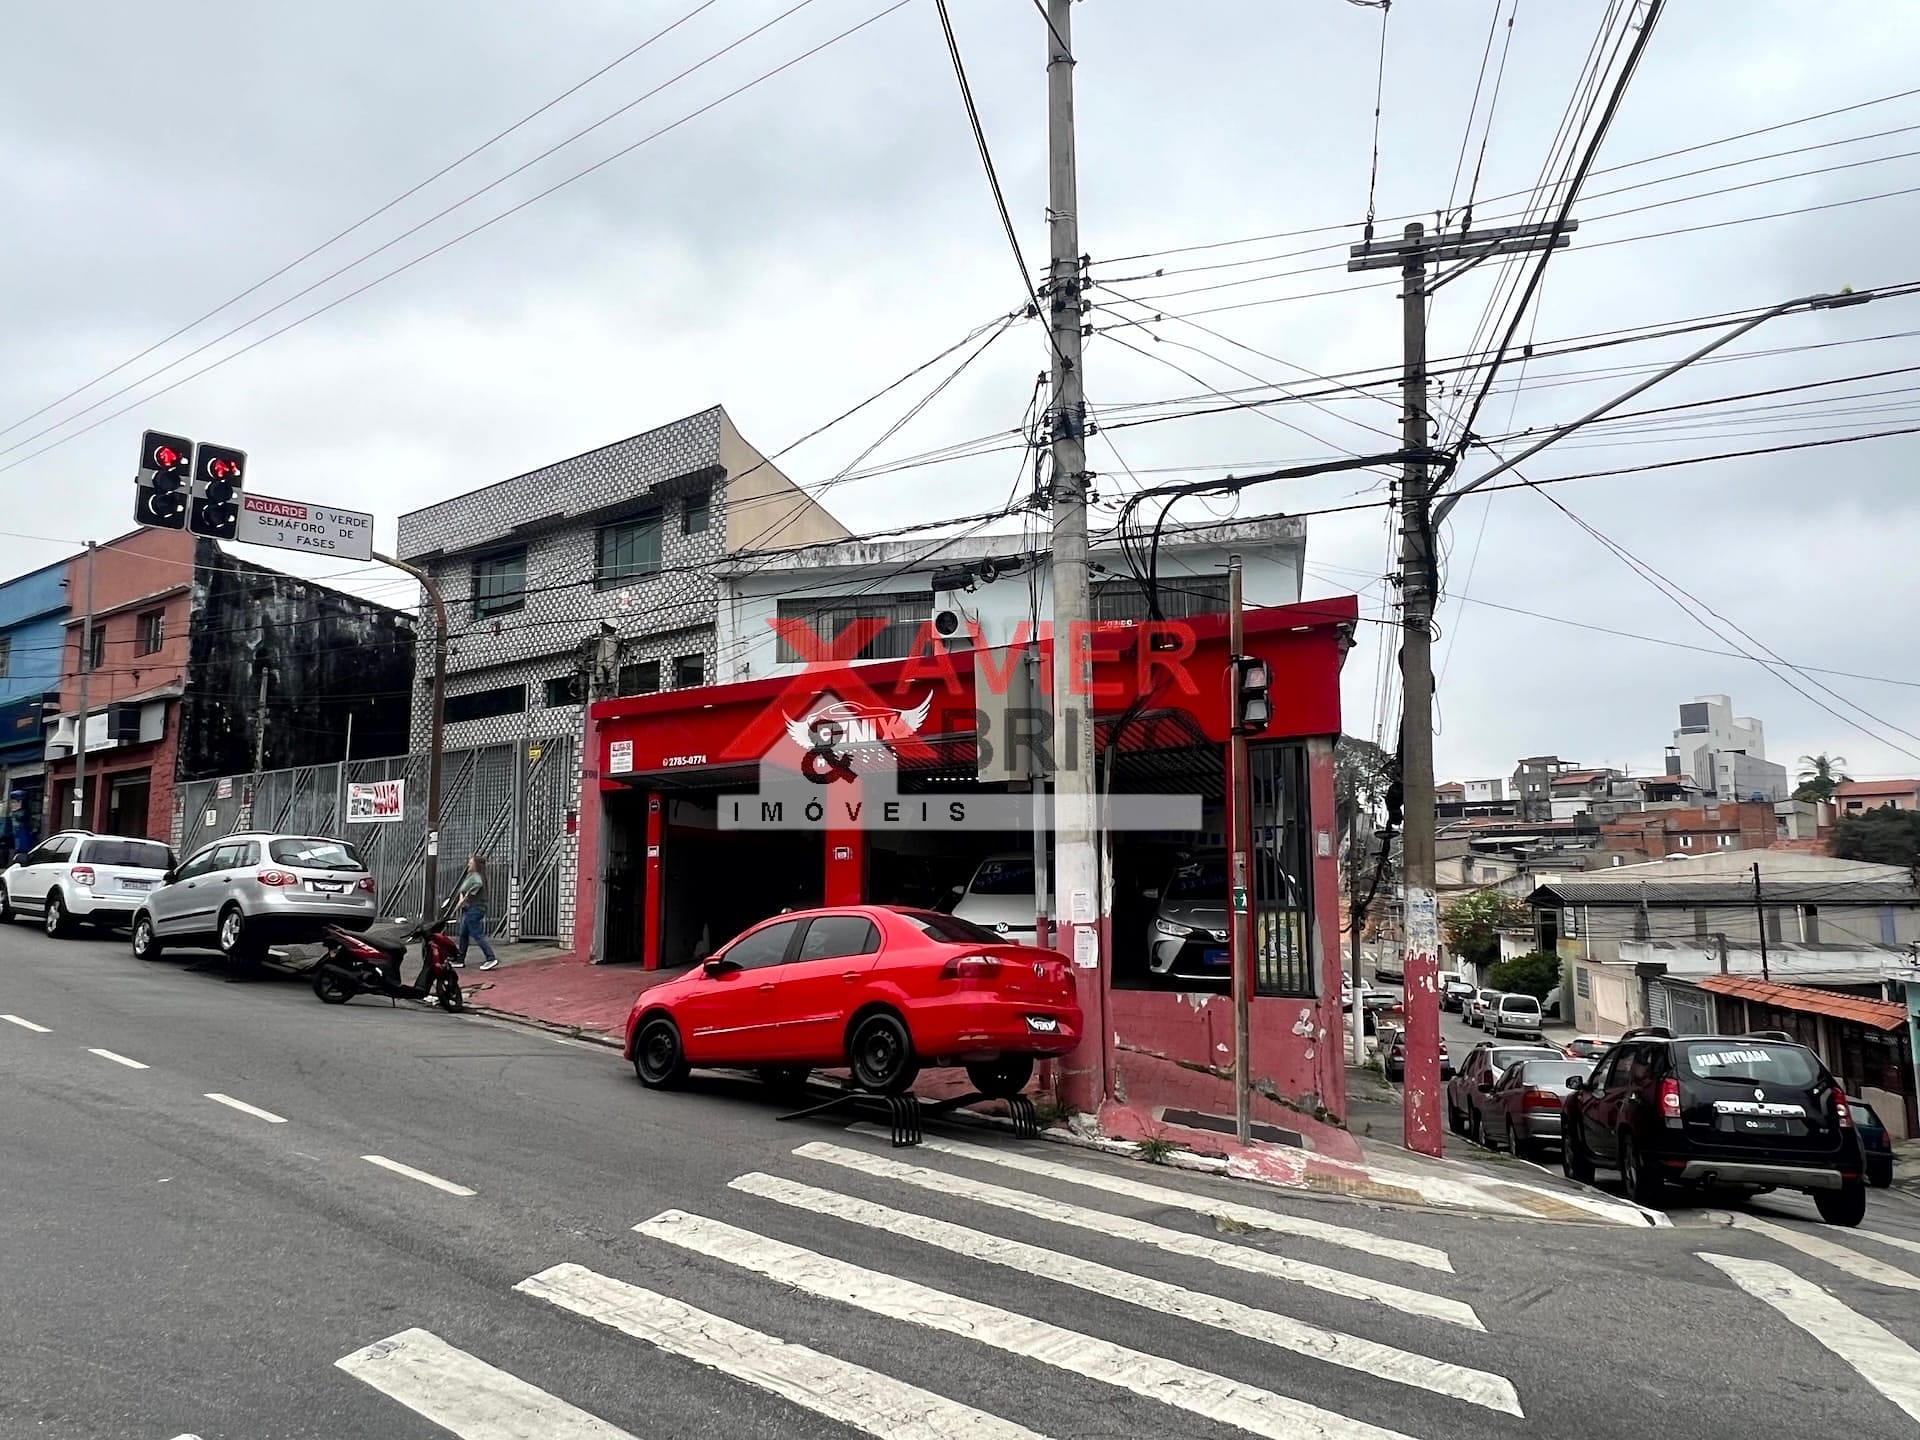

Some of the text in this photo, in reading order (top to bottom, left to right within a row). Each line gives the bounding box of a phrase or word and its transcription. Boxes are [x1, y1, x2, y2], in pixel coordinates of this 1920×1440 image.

[246, 500, 369, 528] AGUARDE O VERDE
[258, 515, 354, 539] SEMÁFORO DE
[296, 535, 335, 549] FASES
[1696, 1050, 1771, 1067] SEM ENTRADA
